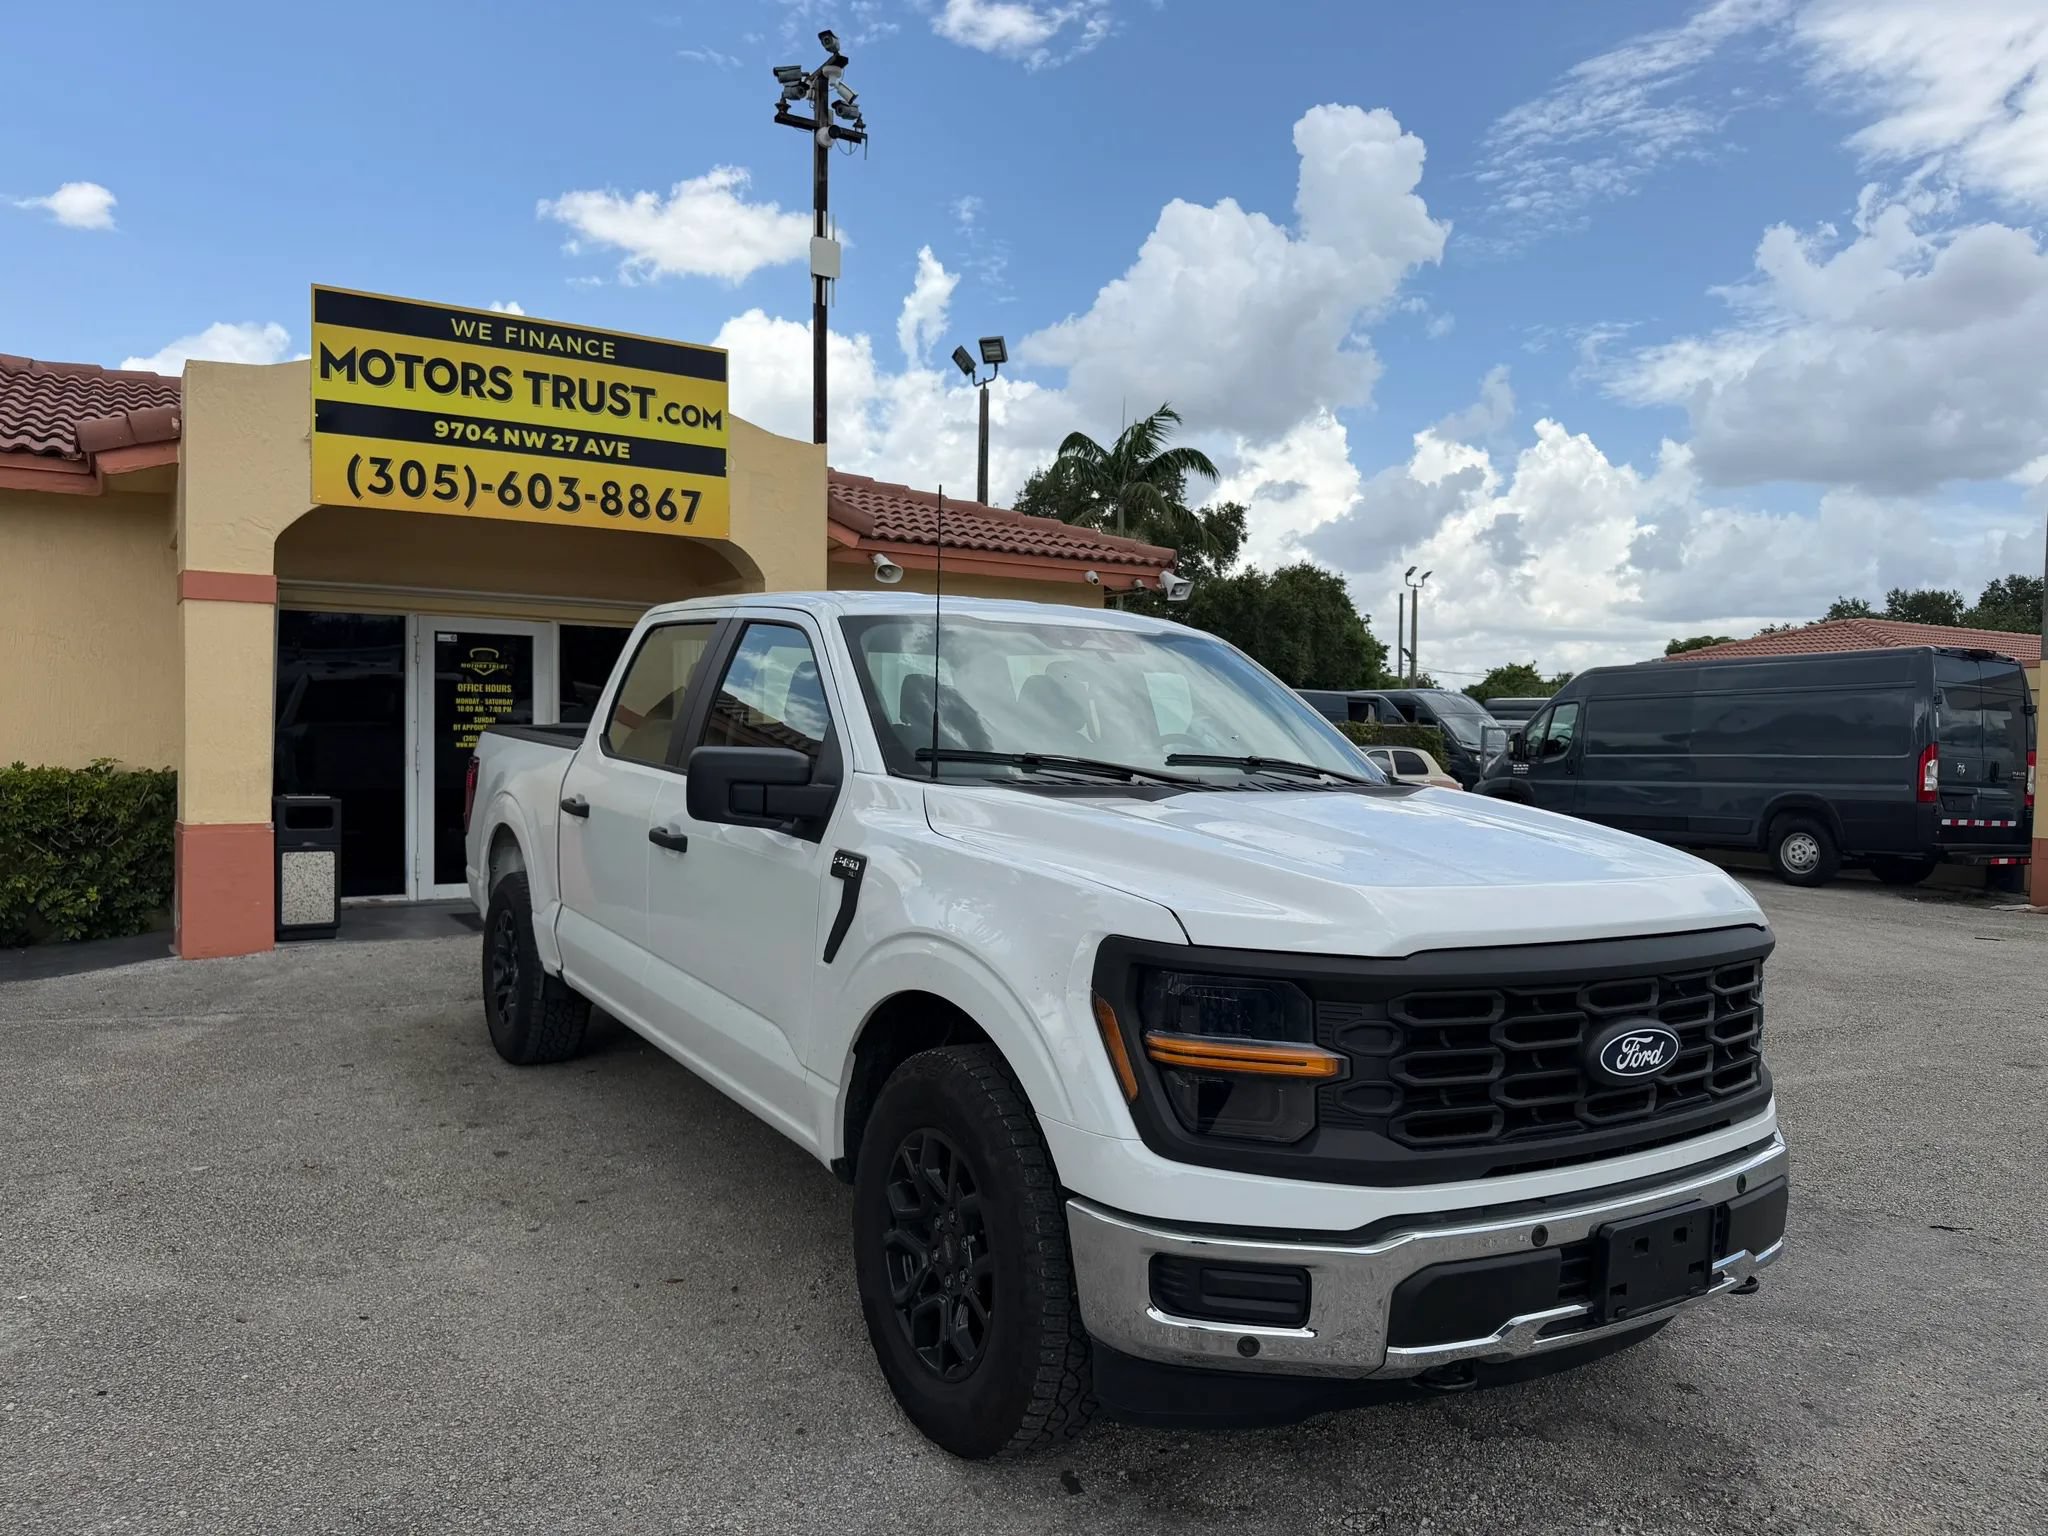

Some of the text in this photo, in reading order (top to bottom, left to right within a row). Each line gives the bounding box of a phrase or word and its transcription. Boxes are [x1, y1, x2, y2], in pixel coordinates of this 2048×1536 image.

[450, 317, 616, 360] WE FINANCE
[319, 341, 513, 403] MOTORS
[433, 419, 631, 460] 9704 NW 27 AVE
[346, 452, 703, 526] (305)-603-8867
[457, 684, 512, 693] OFFICE HOURS
[1616, 1036, 1665, 1070] Ford
